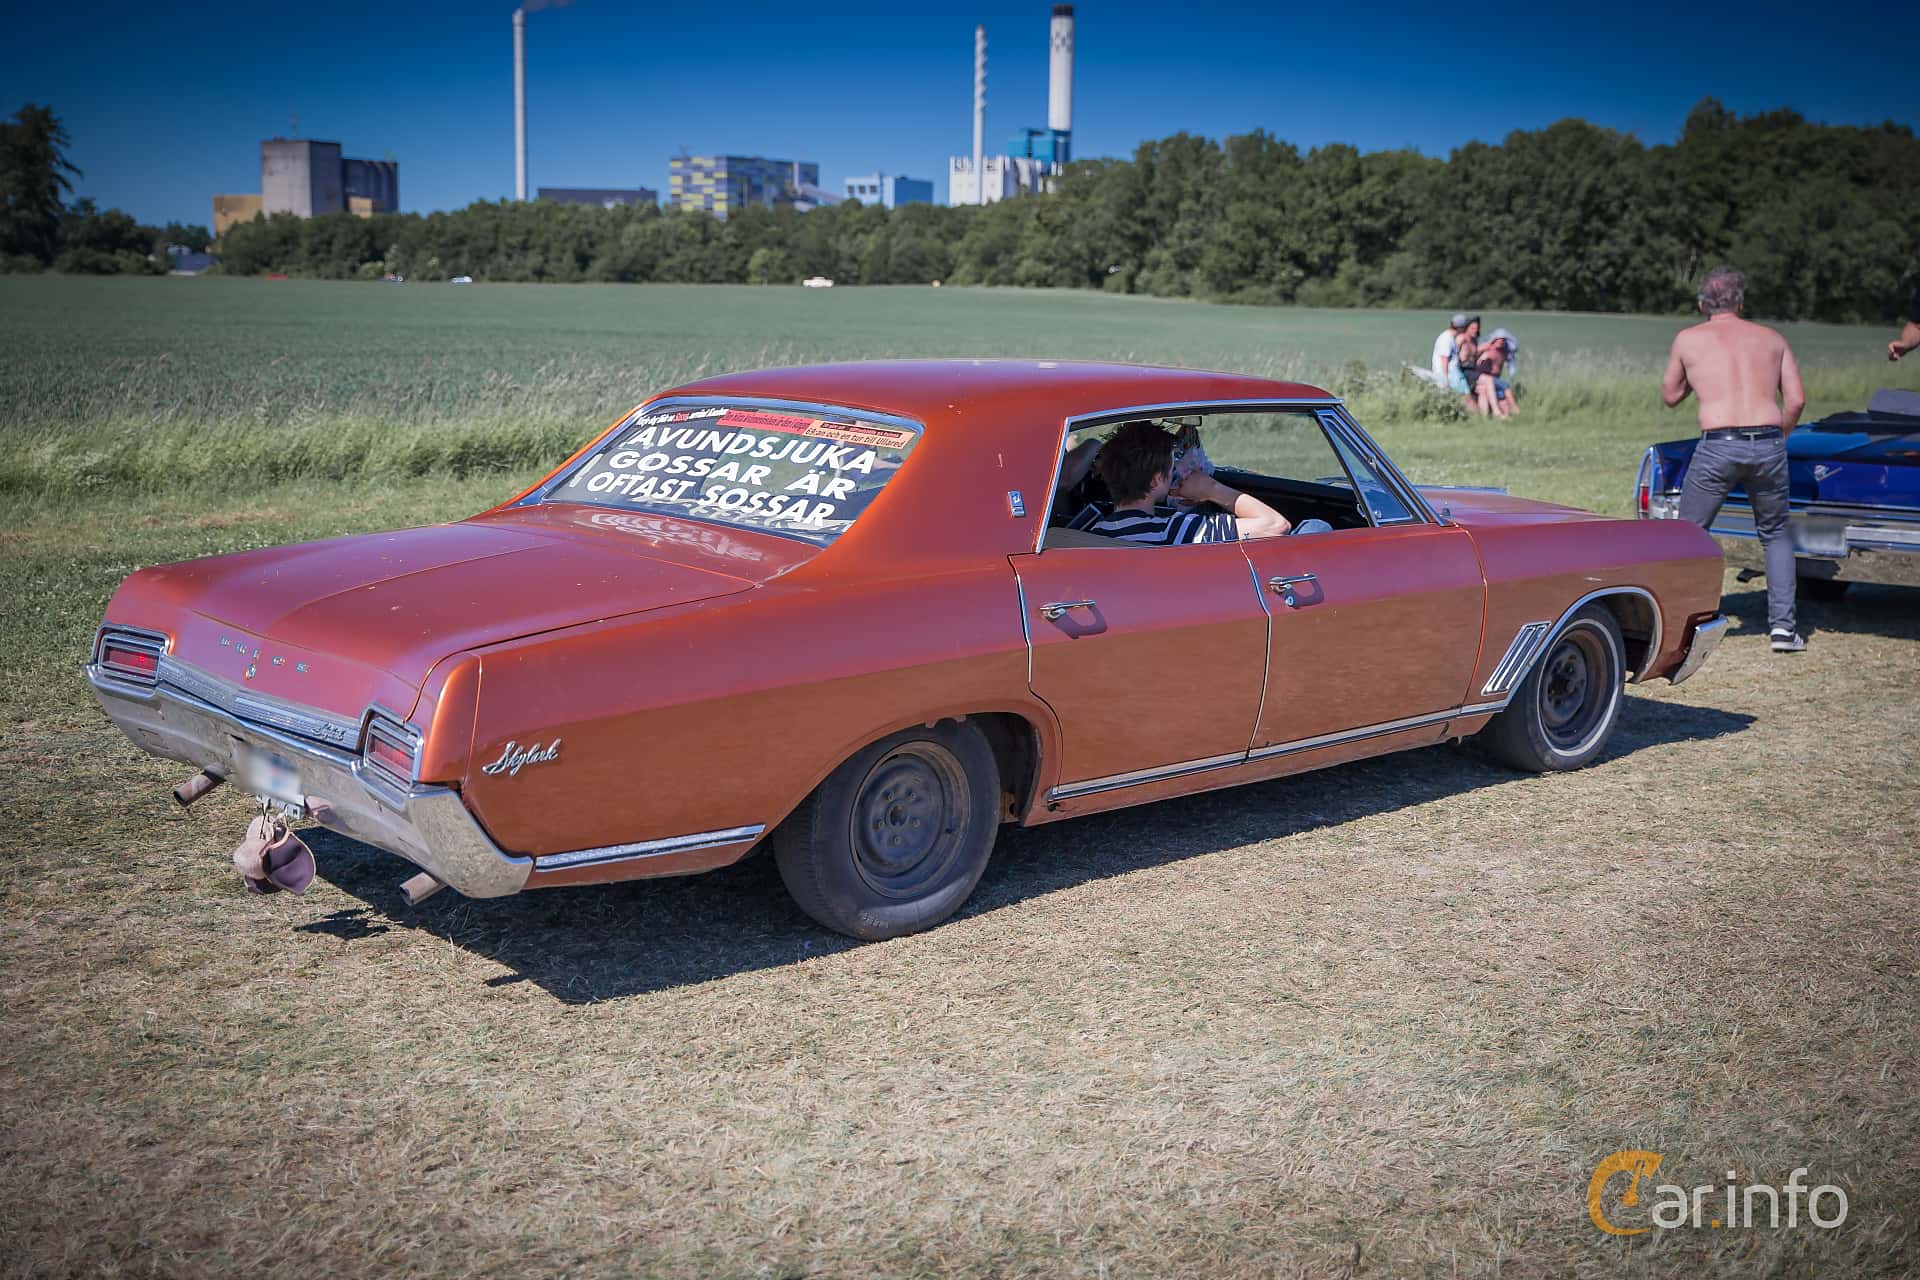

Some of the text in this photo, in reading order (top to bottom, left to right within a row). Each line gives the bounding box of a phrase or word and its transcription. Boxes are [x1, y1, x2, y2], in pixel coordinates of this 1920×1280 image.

[628, 427, 877, 474] AVUNDSJUKA
[587, 472, 835, 526] OFTAST SOSSAR
[609, 451, 856, 500] GOSSAR ÄR
[481, 738, 562, 777] Skylark
